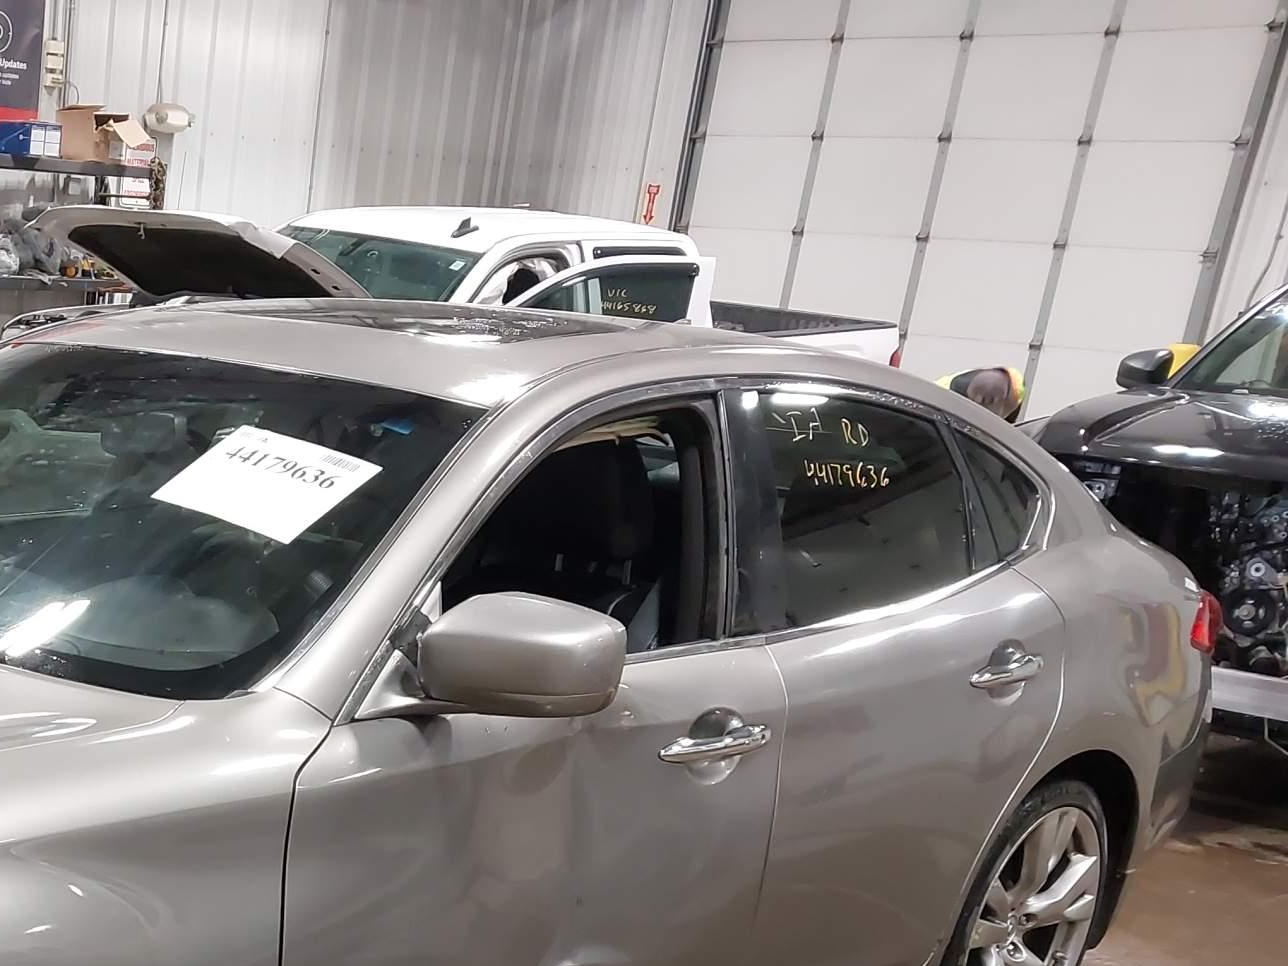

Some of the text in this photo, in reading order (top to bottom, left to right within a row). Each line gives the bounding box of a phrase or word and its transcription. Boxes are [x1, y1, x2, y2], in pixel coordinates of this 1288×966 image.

[0, 57, 28, 70] Updates
[841, 418, 869, 446] RD
[225, 446, 342, 489] 44179636
[804, 459, 890, 489] 44179636
